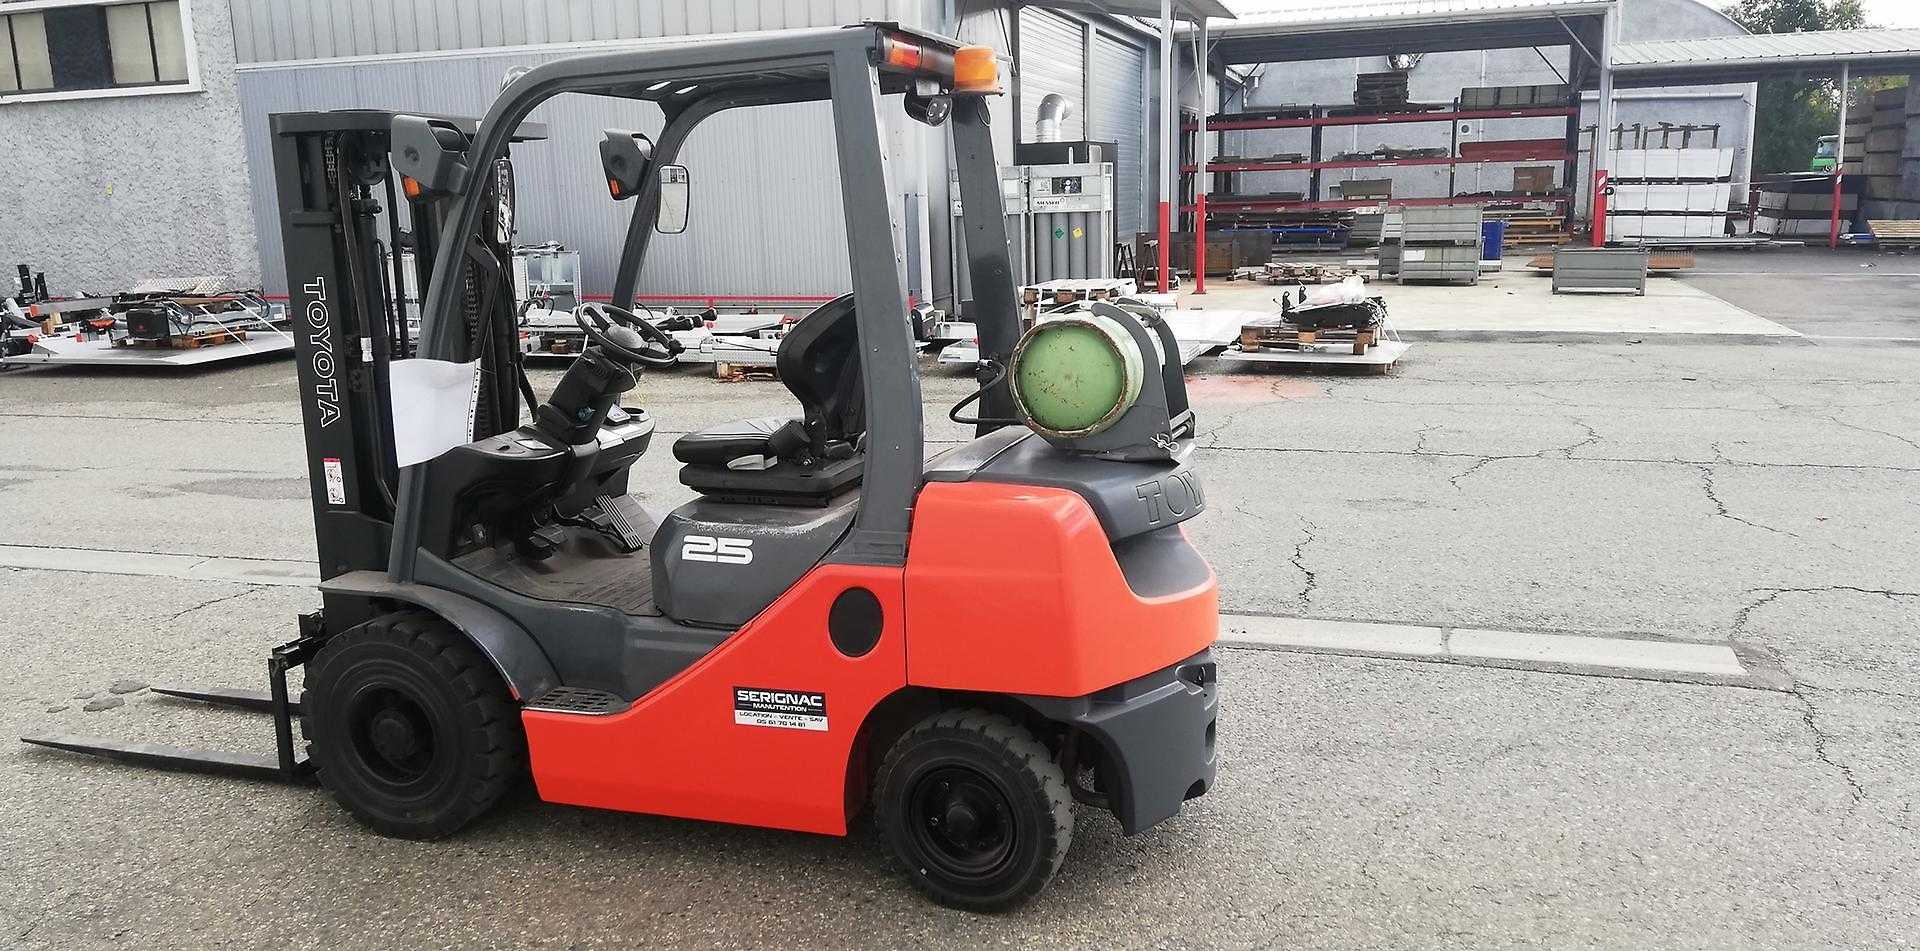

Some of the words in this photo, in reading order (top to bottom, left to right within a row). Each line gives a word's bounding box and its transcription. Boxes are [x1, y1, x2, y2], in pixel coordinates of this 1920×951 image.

[303, 276, 341, 428] TOYOTA
[681, 535, 753, 565] 25
[737, 690, 823, 707] SERIGNAC
[739, 711, 773, 719] LOCATION
[752, 703, 807, 712] MANUTENTION
